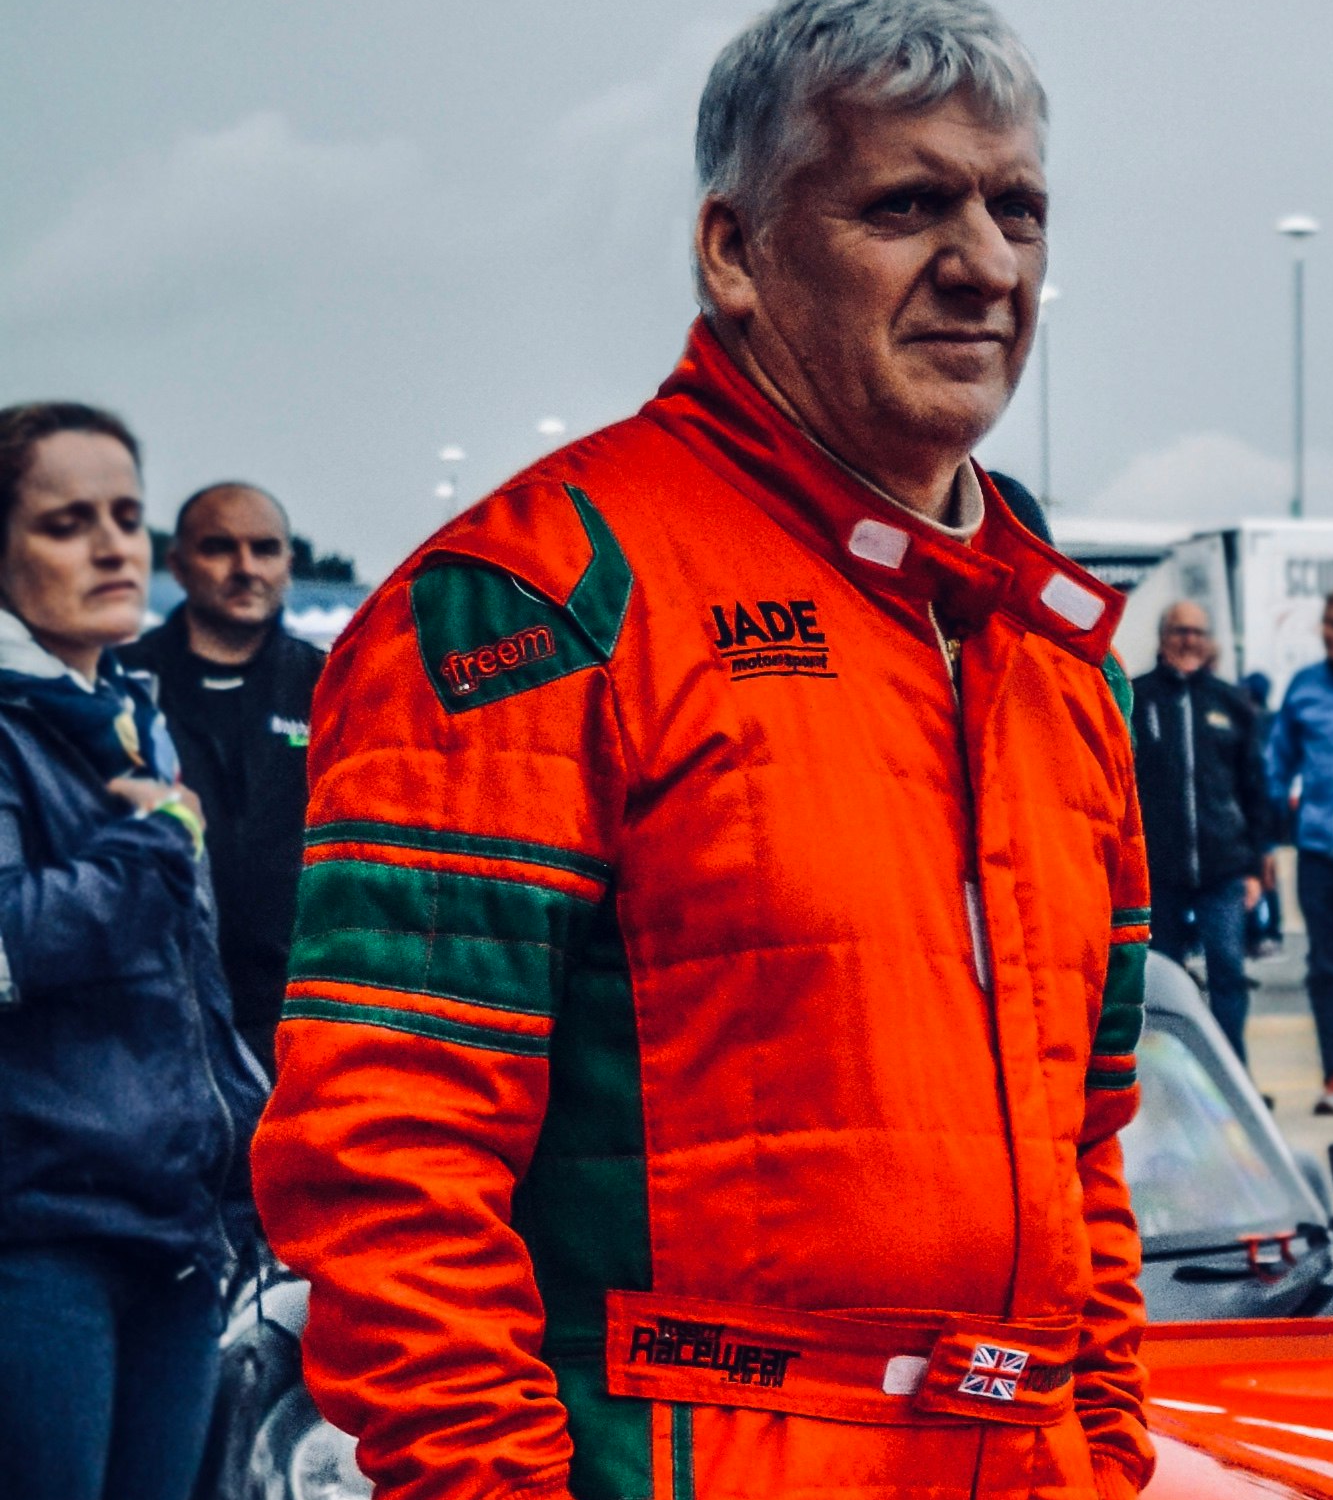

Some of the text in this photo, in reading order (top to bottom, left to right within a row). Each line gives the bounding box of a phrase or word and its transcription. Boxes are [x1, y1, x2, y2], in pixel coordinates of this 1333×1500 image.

[711, 600, 826, 649] JADE
[443, 627, 555, 692] freem
[630, 1326, 801, 1380] Racewear
